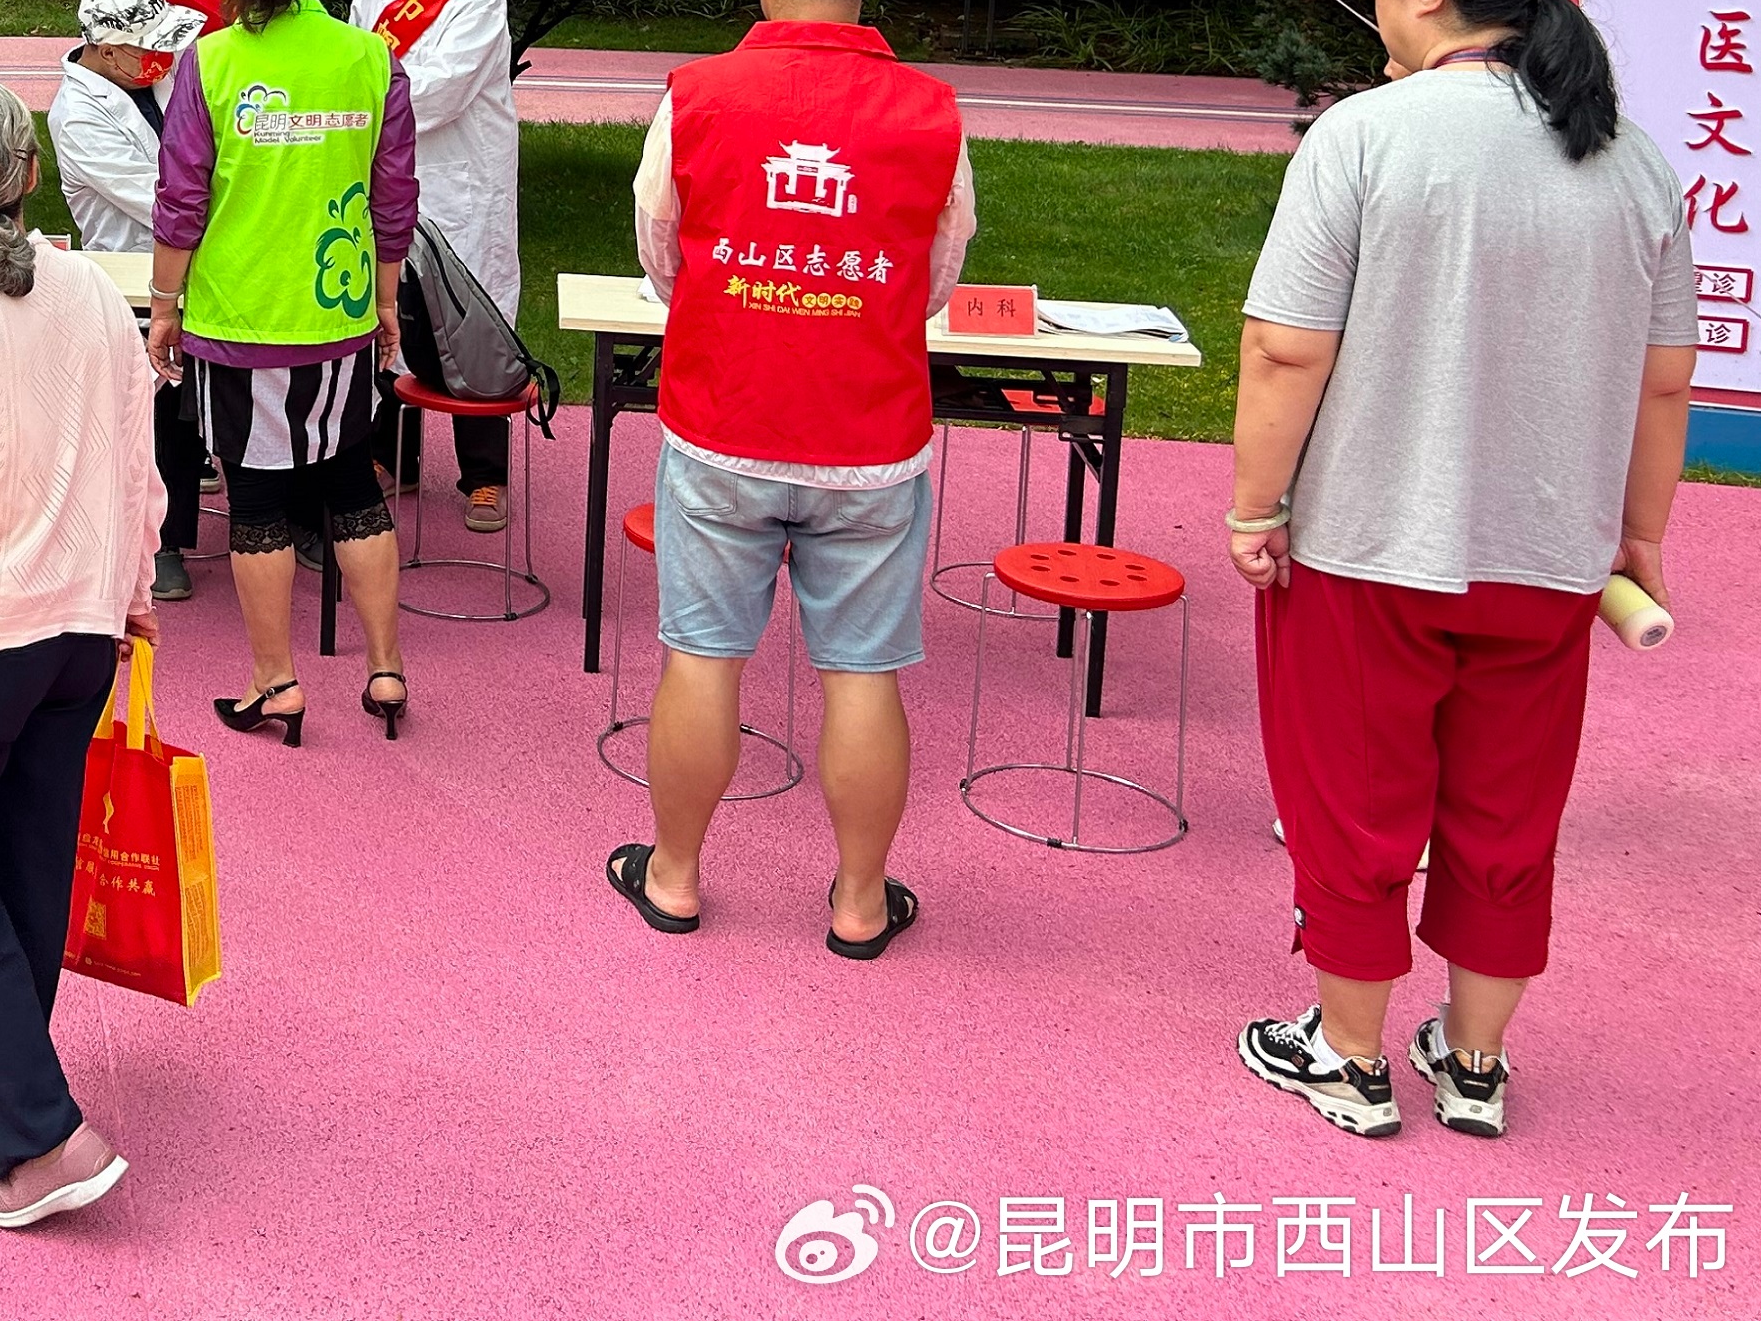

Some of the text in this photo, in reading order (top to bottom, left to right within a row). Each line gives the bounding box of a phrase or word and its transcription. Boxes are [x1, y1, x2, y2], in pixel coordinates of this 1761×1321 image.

[254, 112, 369, 131] 昆明文明志愿者
[711, 238, 894, 284] 西山区志愿者
[967, 297, 1016, 318] 内科
